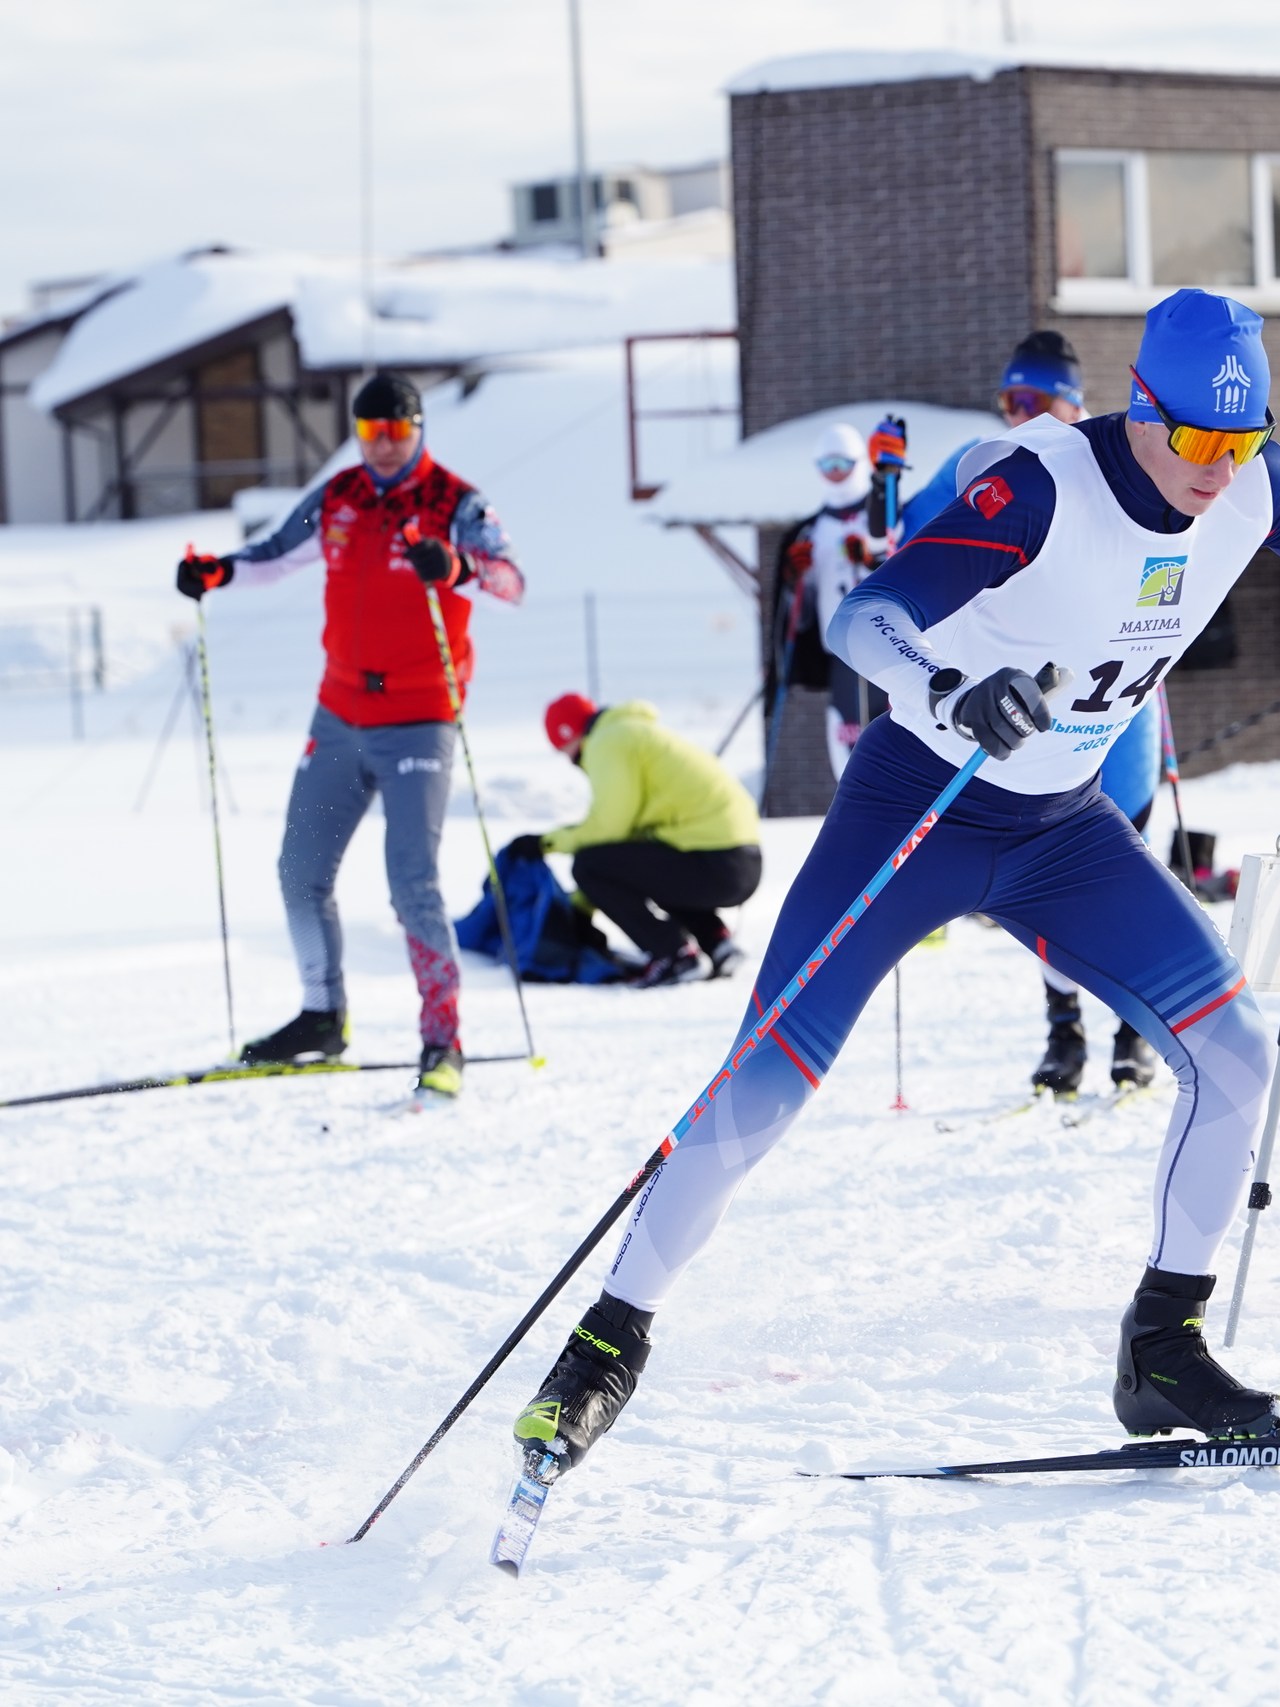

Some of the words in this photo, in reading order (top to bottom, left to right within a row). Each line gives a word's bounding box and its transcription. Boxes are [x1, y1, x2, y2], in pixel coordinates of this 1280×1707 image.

[870, 615, 895, 636] РУС
[1118, 617, 1181, 634] MAXIMA
[1070, 655, 1172, 713] 14
[1073, 734, 1111, 752] 2026
[633, 1162, 668, 1227] VICTORY
[611, 1232, 633, 1277] CODE
